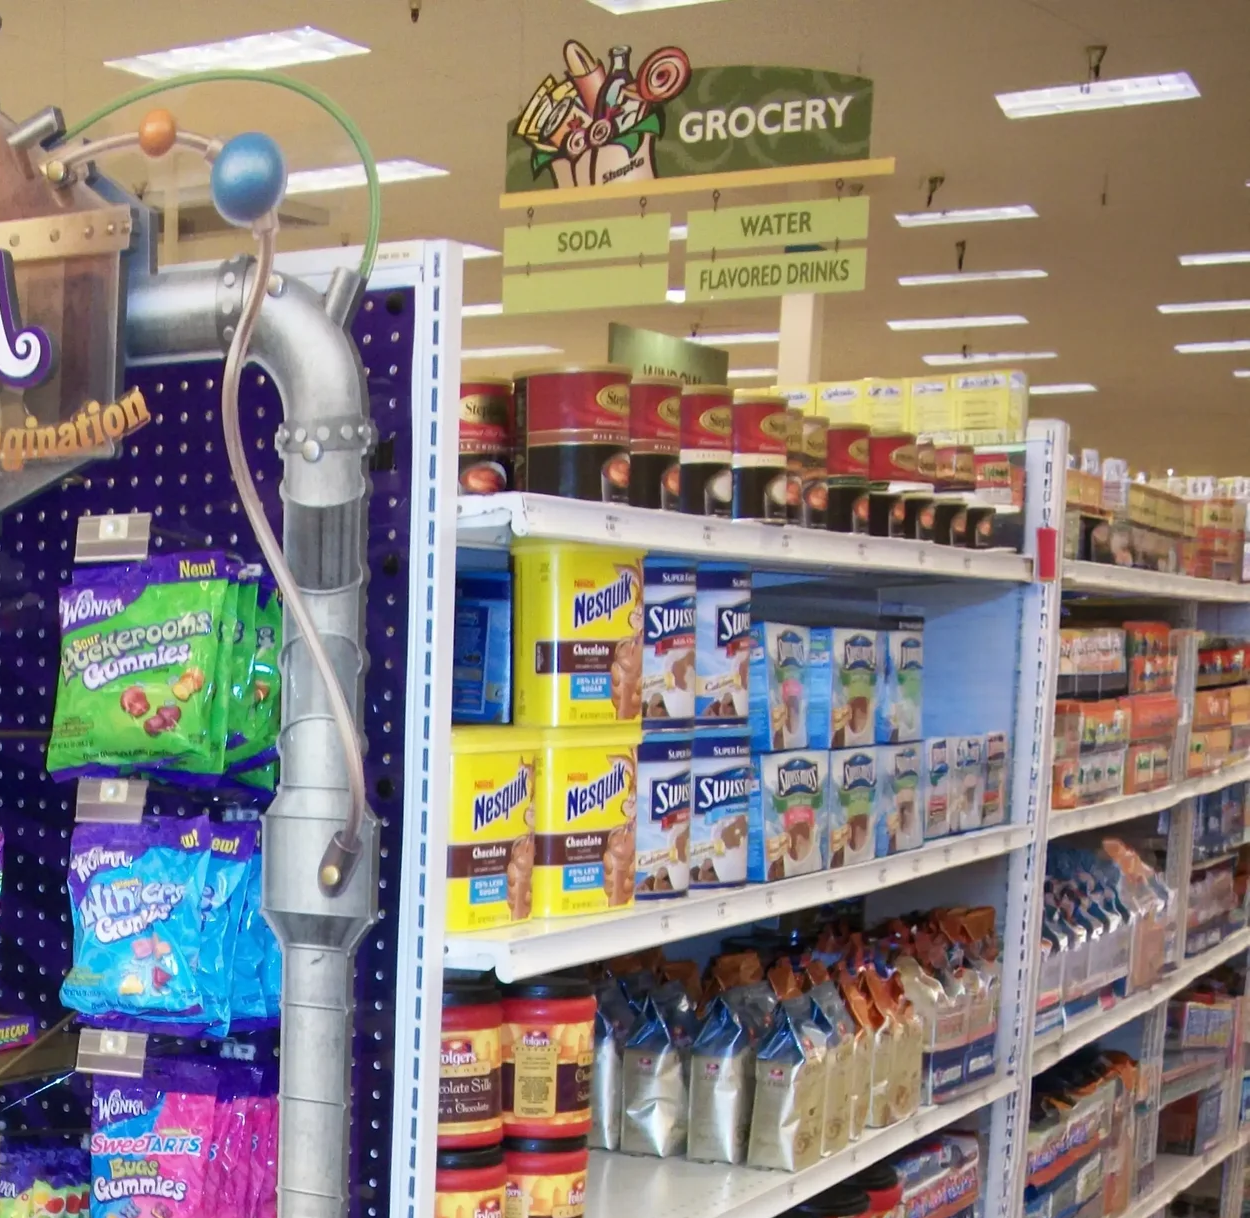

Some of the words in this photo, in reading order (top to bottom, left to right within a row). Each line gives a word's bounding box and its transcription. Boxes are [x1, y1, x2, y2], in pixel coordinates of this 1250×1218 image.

[678, 95, 853, 144] GROCERY
[740, 211, 812, 236] WATER
[558, 229, 612, 252] SODA
[699, 264, 782, 291] FLAVORED
[786, 259, 849, 285] DRINKS
[180, 559, 217, 579] New!
[60, 589, 125, 629] WONKA
[574, 572, 632, 628] Nesquik
[573, 644, 610, 656] Chocolate
[83, 643, 192, 690] Gummies
[474, 766, 528, 830] Nesquik
[567, 762, 625, 821] Nesquik
[212, 837, 240, 855] ew!
[472, 847, 506, 859] Chocolate
[566, 836, 602, 848] Chocolate
[471, 1079, 491, 1092] Silk
[92, 1089, 147, 1121] WONKA
[94, 1176, 187, 1202] Gummies
